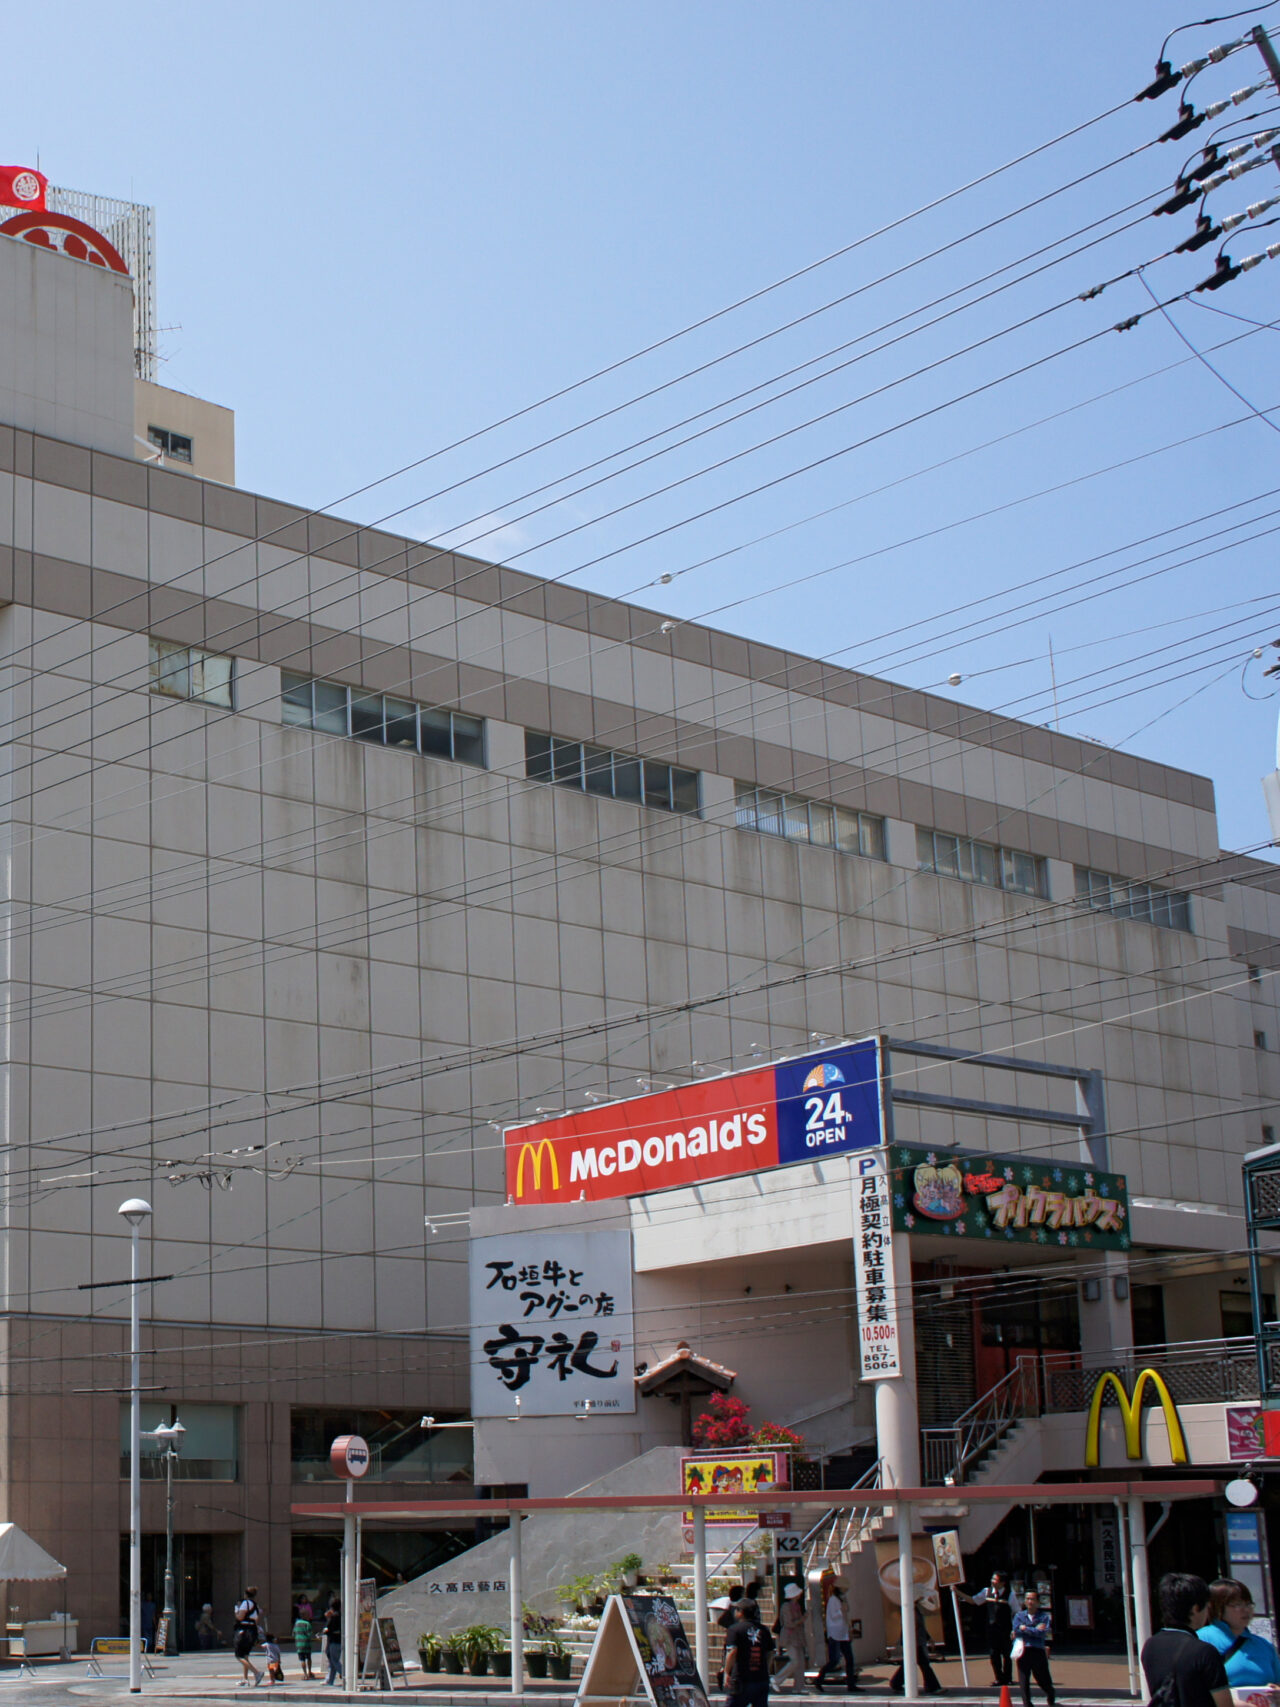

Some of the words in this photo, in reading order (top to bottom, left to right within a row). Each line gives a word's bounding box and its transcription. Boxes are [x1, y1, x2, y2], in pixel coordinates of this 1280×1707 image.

[569, 1112, 767, 1183] McDonald's
[805, 1126, 846, 1148] OPEN
[859, 1158, 876, 1175] P
[986, 1183, 1123, 1232] プリクラハウス
[860, 1177, 888, 1322] 月極契約駐車募集
[485, 1260, 584, 1290] 石垣牛と
[520, 1290, 615, 1318] アグーの店
[862, 1325, 896, 1341] 10,500円
[483, 1324, 619, 1391] 守礼
[864, 1353, 895, 1362] 867-
[864, 1361, 897, 1370] 5064
[777, 1537, 800, 1552] K2
